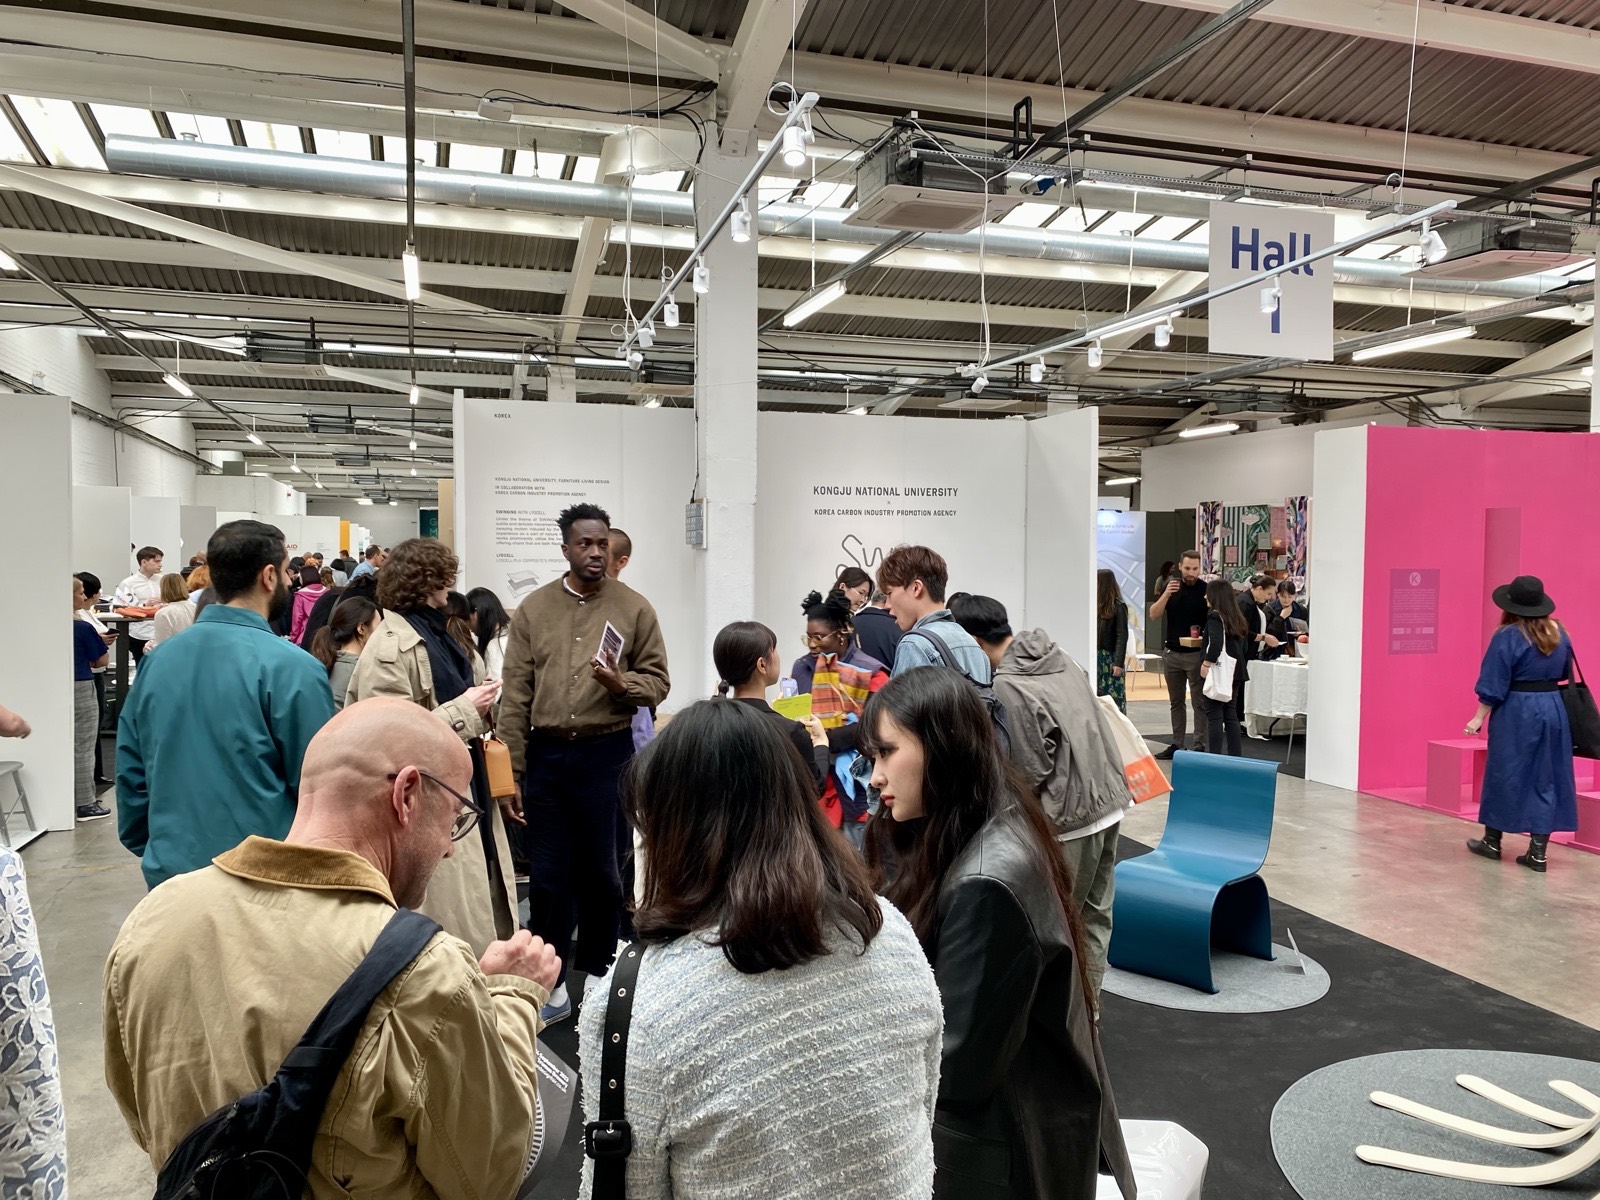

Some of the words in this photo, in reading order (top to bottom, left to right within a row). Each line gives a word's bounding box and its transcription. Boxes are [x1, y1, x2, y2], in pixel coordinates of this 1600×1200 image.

[1231, 225, 1314, 277] Hall
[813, 486, 853, 496] KONGJU
[855, 486, 901, 496] NATIONAL
[904, 487, 959, 497] UNIVERSITY
